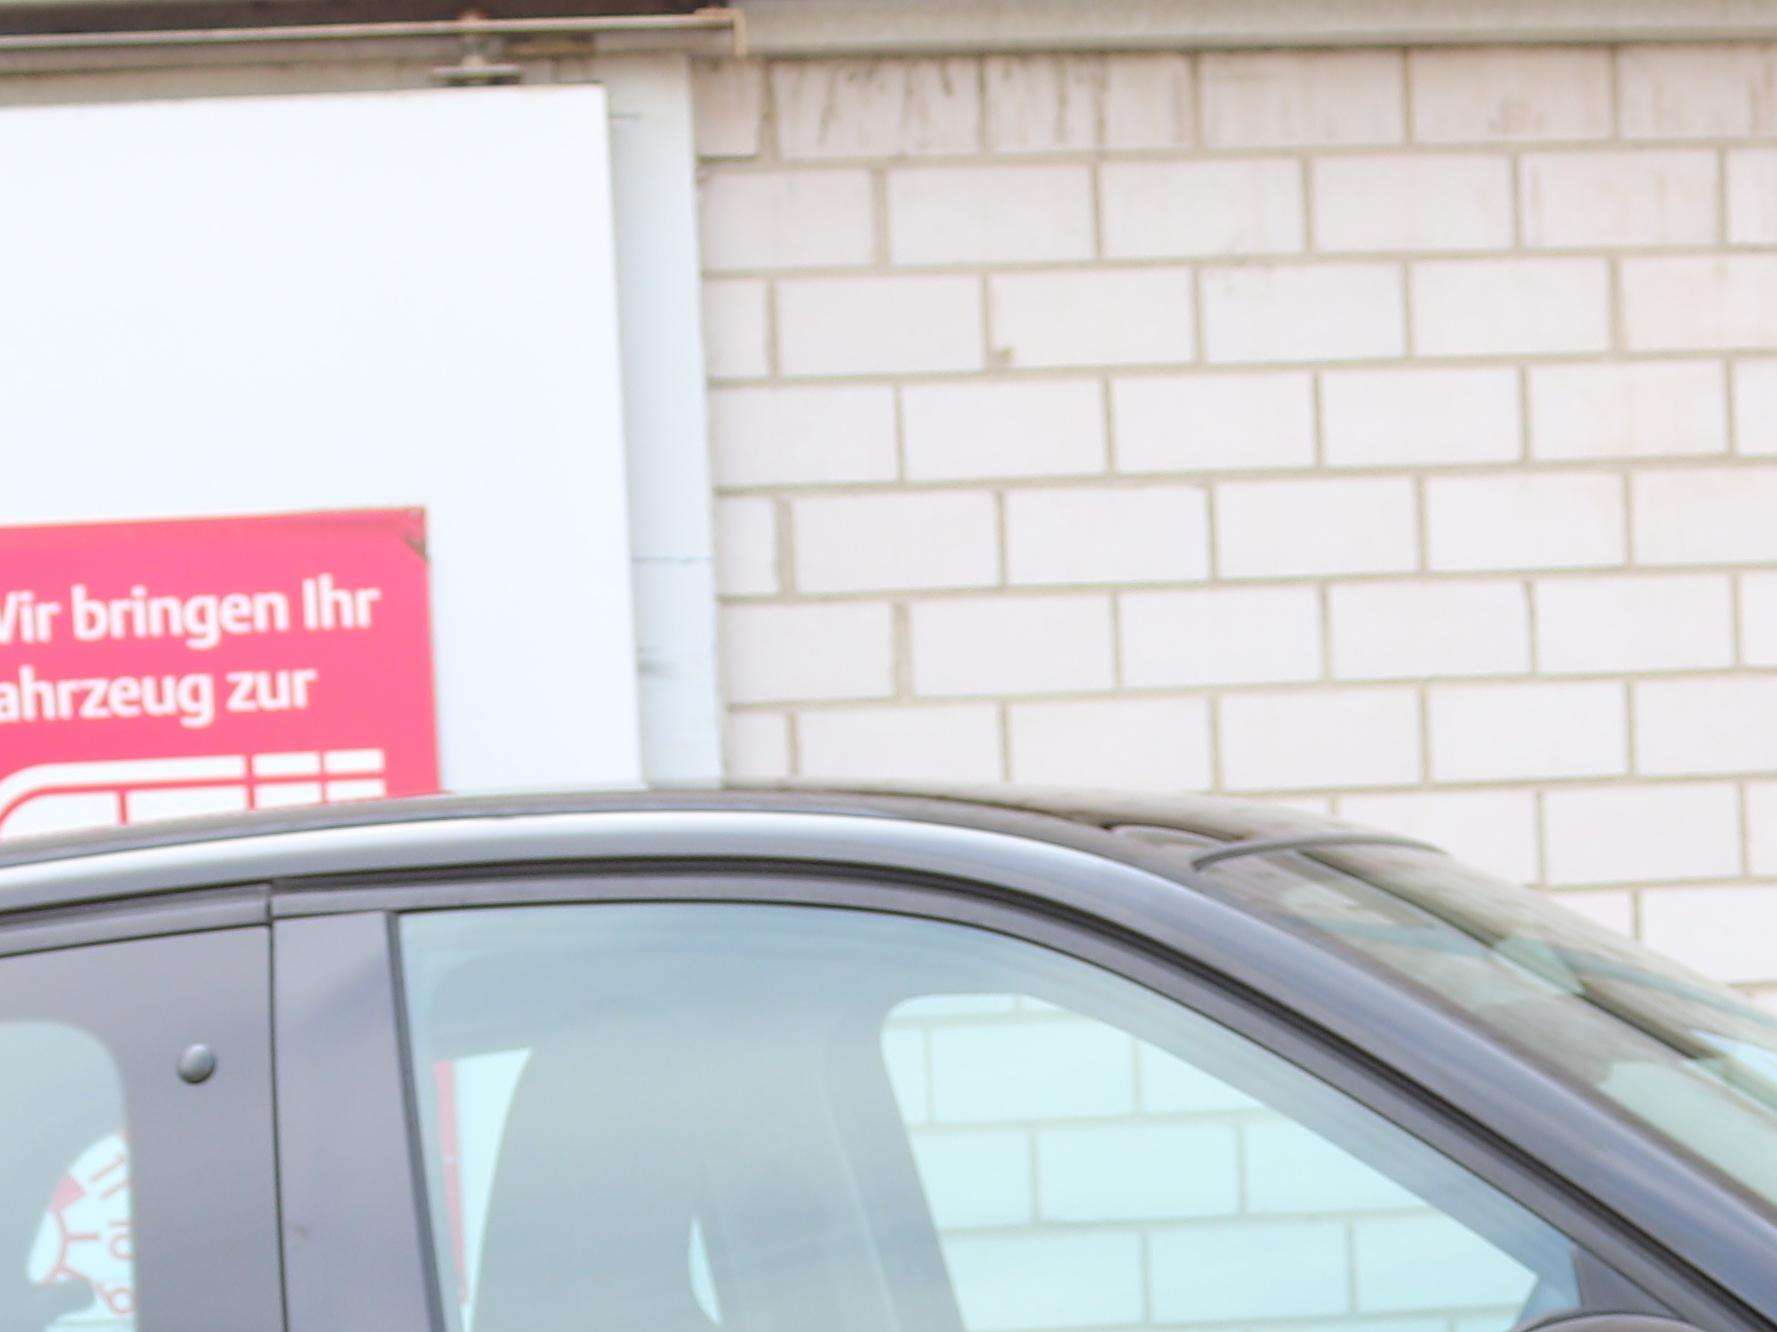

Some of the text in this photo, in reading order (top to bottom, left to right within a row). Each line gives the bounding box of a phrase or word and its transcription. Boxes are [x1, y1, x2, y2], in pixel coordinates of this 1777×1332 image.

[70, 582, 291, 650] bringen
[300, 573, 381, 631] Ihr
[224, 667, 319, 712] zur
